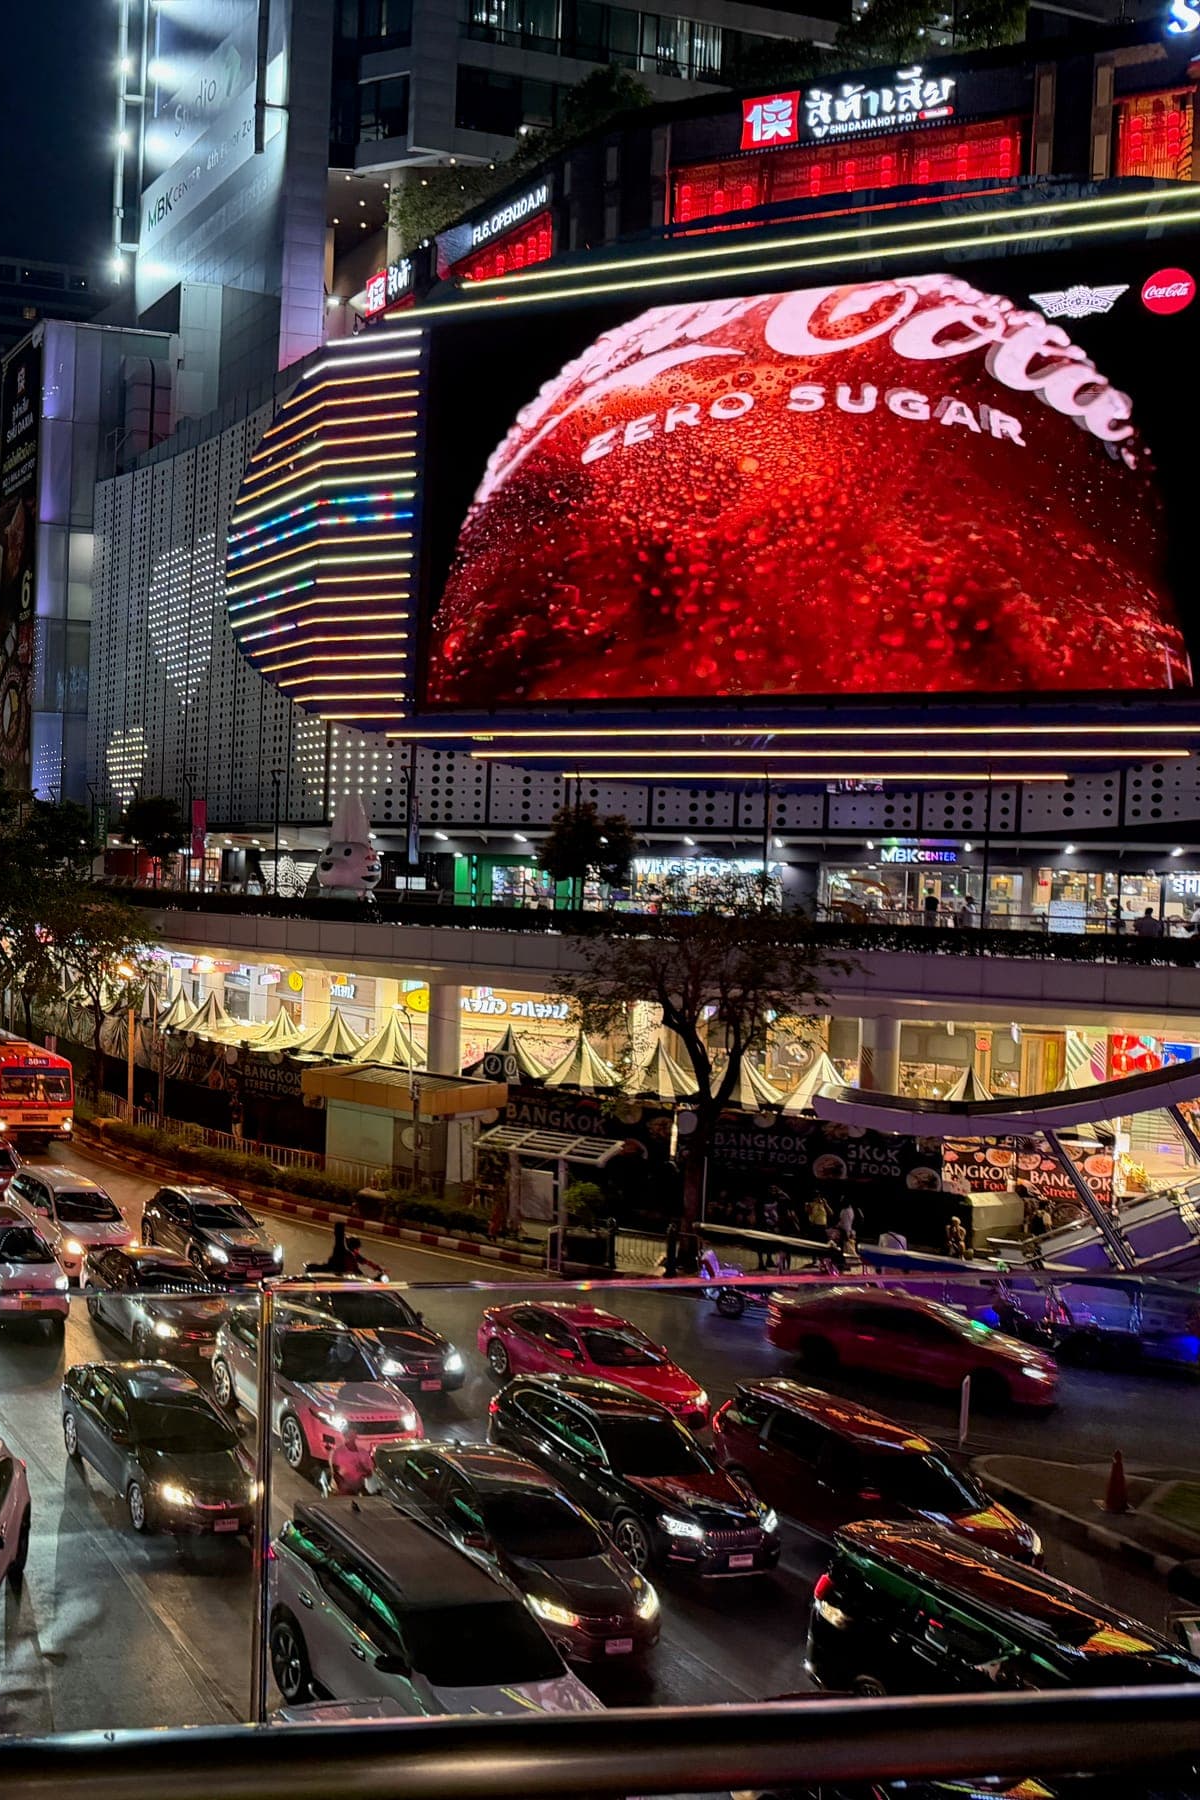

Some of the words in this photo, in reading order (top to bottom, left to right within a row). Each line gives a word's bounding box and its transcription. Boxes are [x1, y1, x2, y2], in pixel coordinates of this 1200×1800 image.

[829, 121, 848, 135] SHU
[849, 117, 876, 131] DAXIA
[876, 115, 896, 128] HOT
[899, 111, 918, 124] POT
[147, 186, 174, 233] MBK
[581, 392, 755, 466] ZERO
[786, 381, 1028, 448] SUGAR
[880, 847, 918, 863] MBK
[918, 850, 957, 863] CENTER
[244, 1064, 301, 1085] BANGKOK
[505, 1102, 607, 1135] BANGKOK
[714, 1131, 808, 1152] BANGKOK
[768, 1151, 808, 1166] FOOD
[859, 1162, 902, 1177] FOOD
[1042, 1186, 1078, 1201] Street
